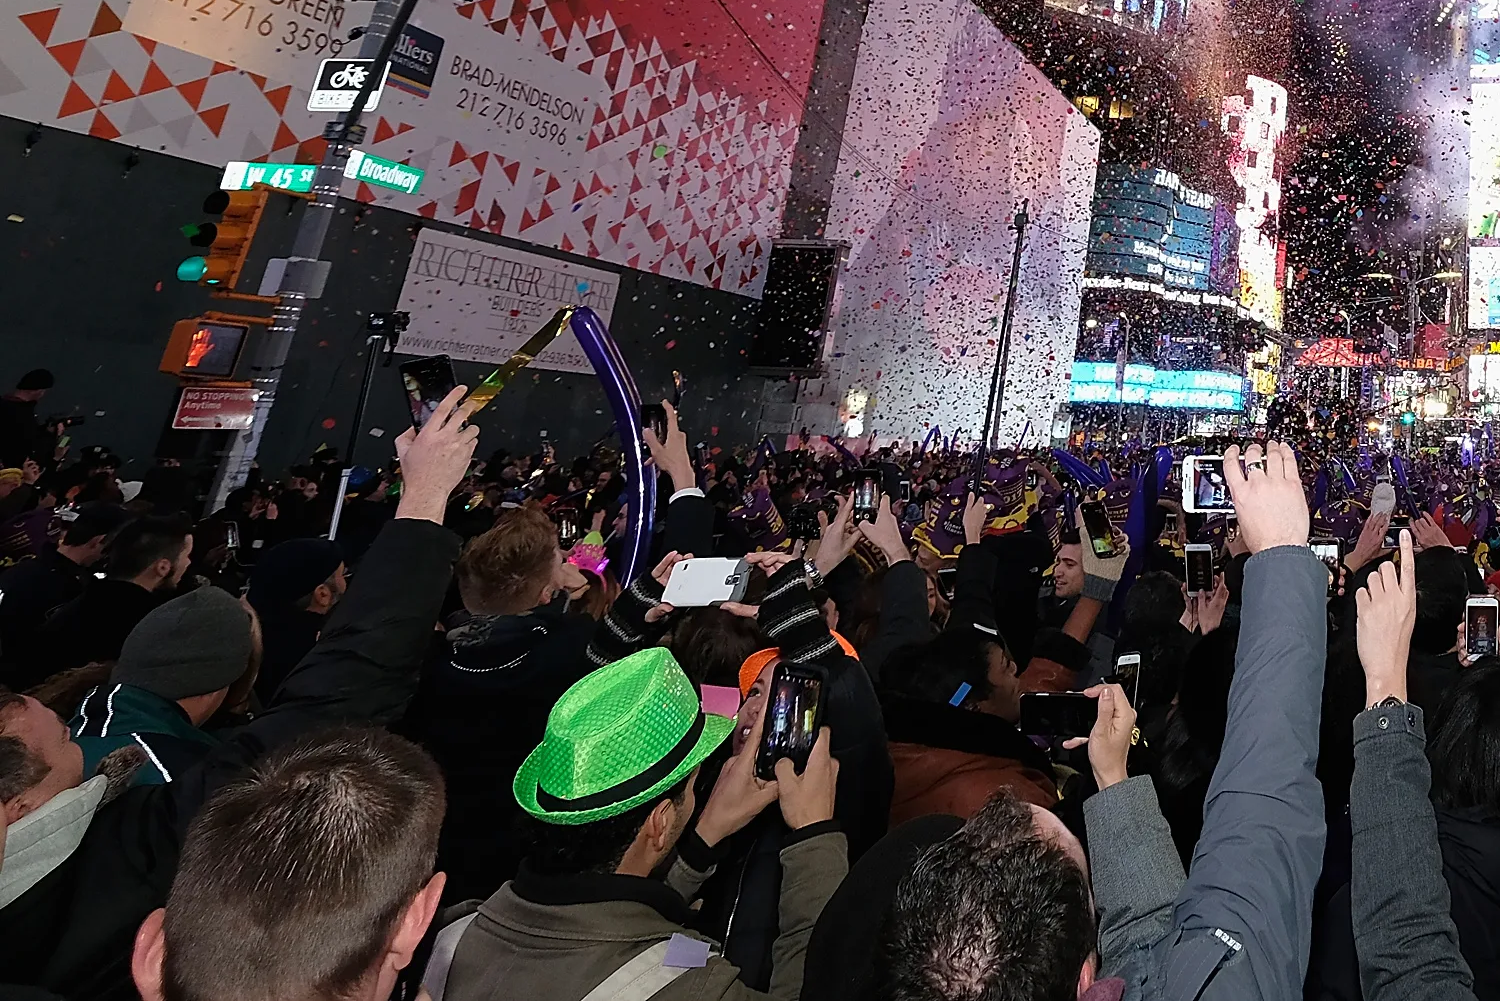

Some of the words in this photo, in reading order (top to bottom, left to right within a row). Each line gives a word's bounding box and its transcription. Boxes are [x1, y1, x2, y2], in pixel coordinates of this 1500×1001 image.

[282, 21, 343, 59] 3599
[450, 55, 586, 125] BRAD-MENDELSON
[456, 88, 488, 117] 212
[493, 102, 525, 131] 716
[529, 119, 568, 146] 3596
[247, 166, 266, 187] W
[269, 167, 295, 189] 45
[299, 167, 315, 182] St
[359, 158, 421, 195] Broadway
[402, 334, 521, 360] www.richterratner.co
[184, 401, 222, 411] Anytime
[186, 392, 199, 400] NO
[201, 392, 246, 401] STOPPING
